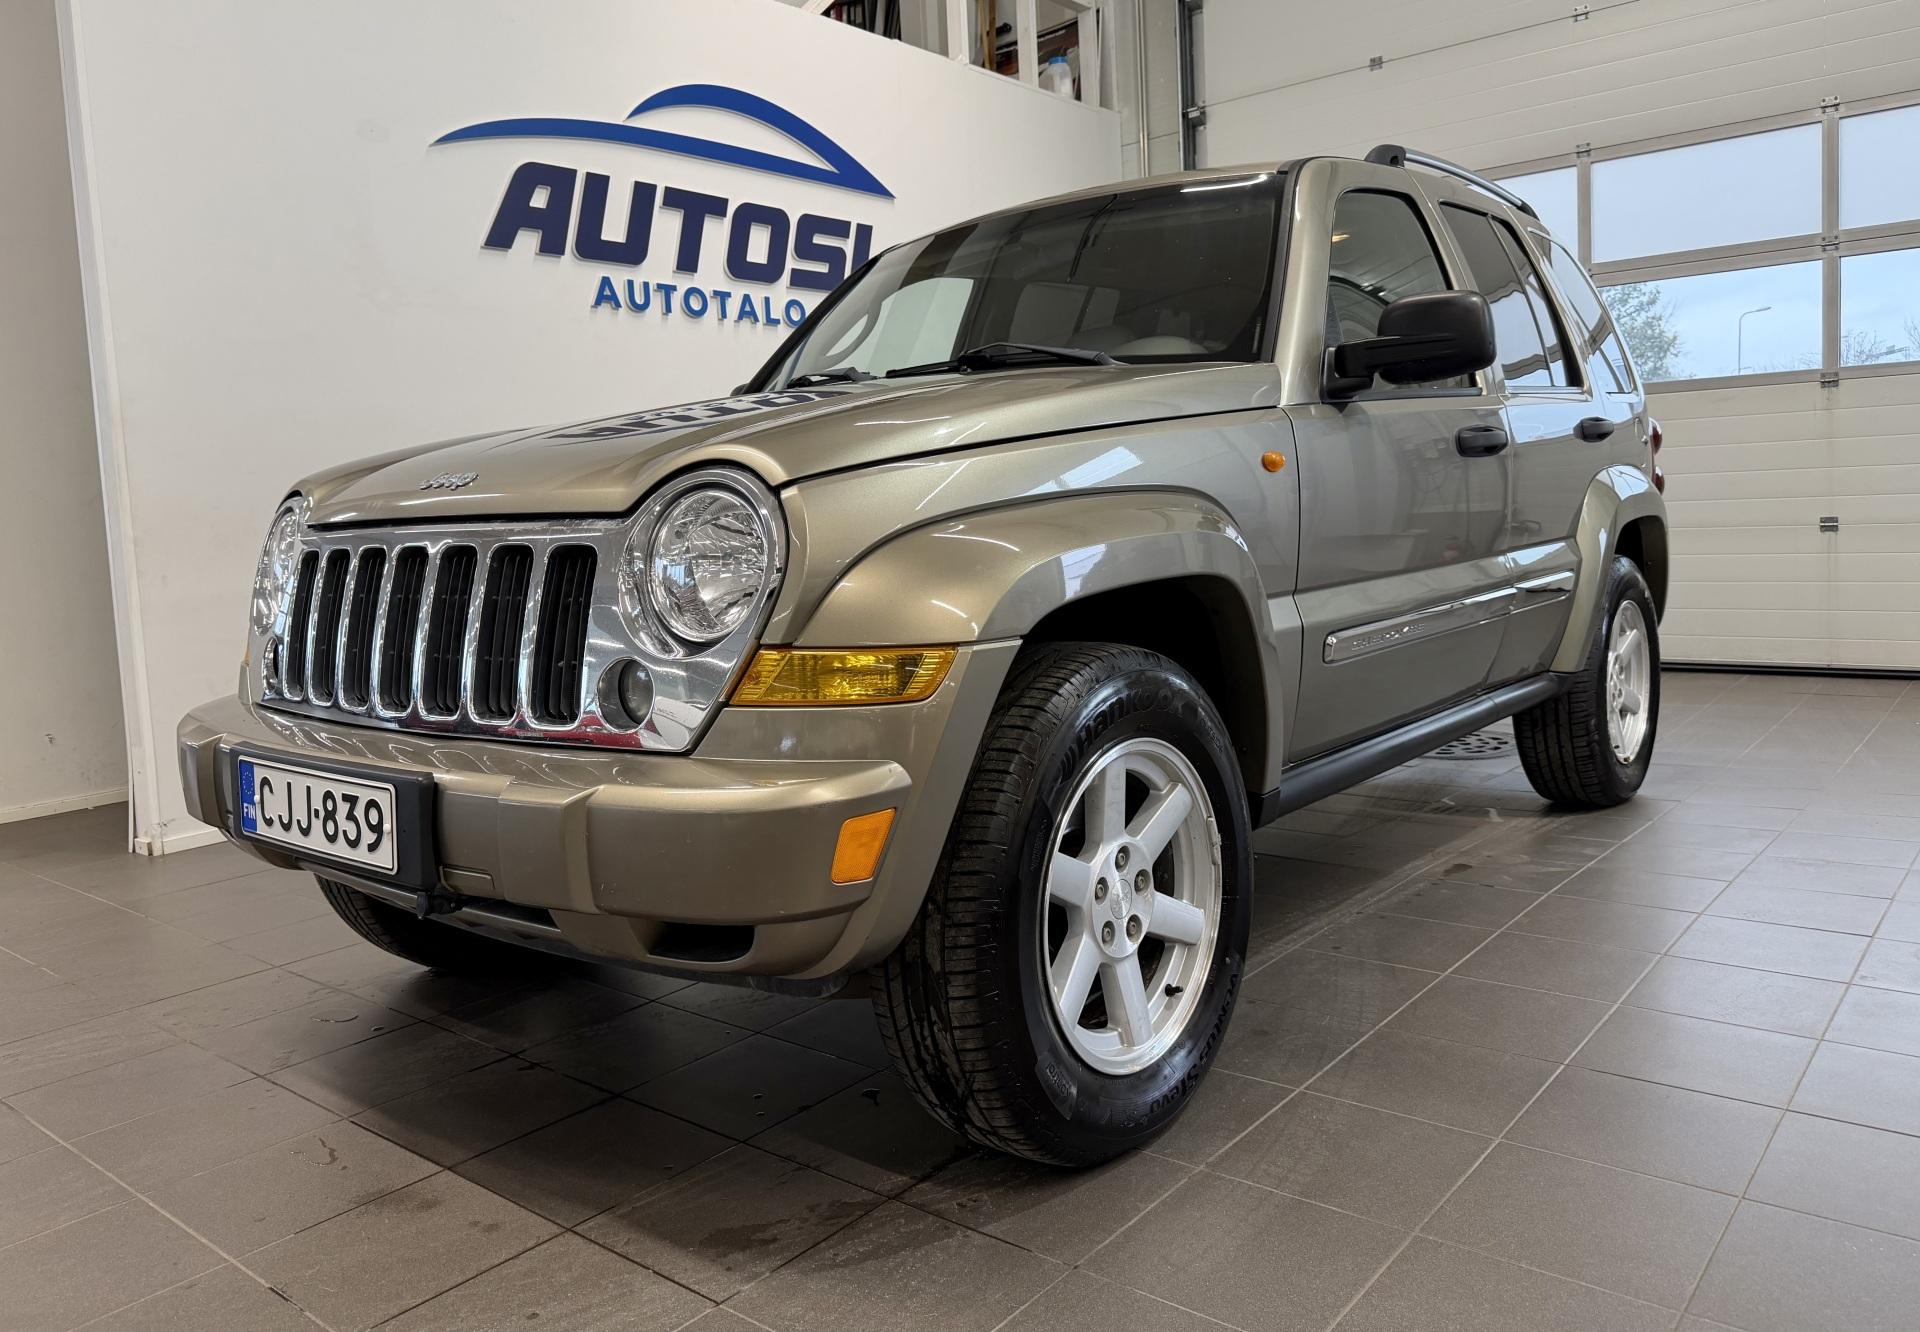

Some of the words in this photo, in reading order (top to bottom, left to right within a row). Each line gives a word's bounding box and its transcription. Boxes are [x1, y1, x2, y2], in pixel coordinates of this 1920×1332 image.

[591, 275, 806, 328] AUTOTALO
[418, 472, 479, 491] Jeep
[243, 802, 256, 820] FIN
[259, 776, 384, 852] CJJ-839
